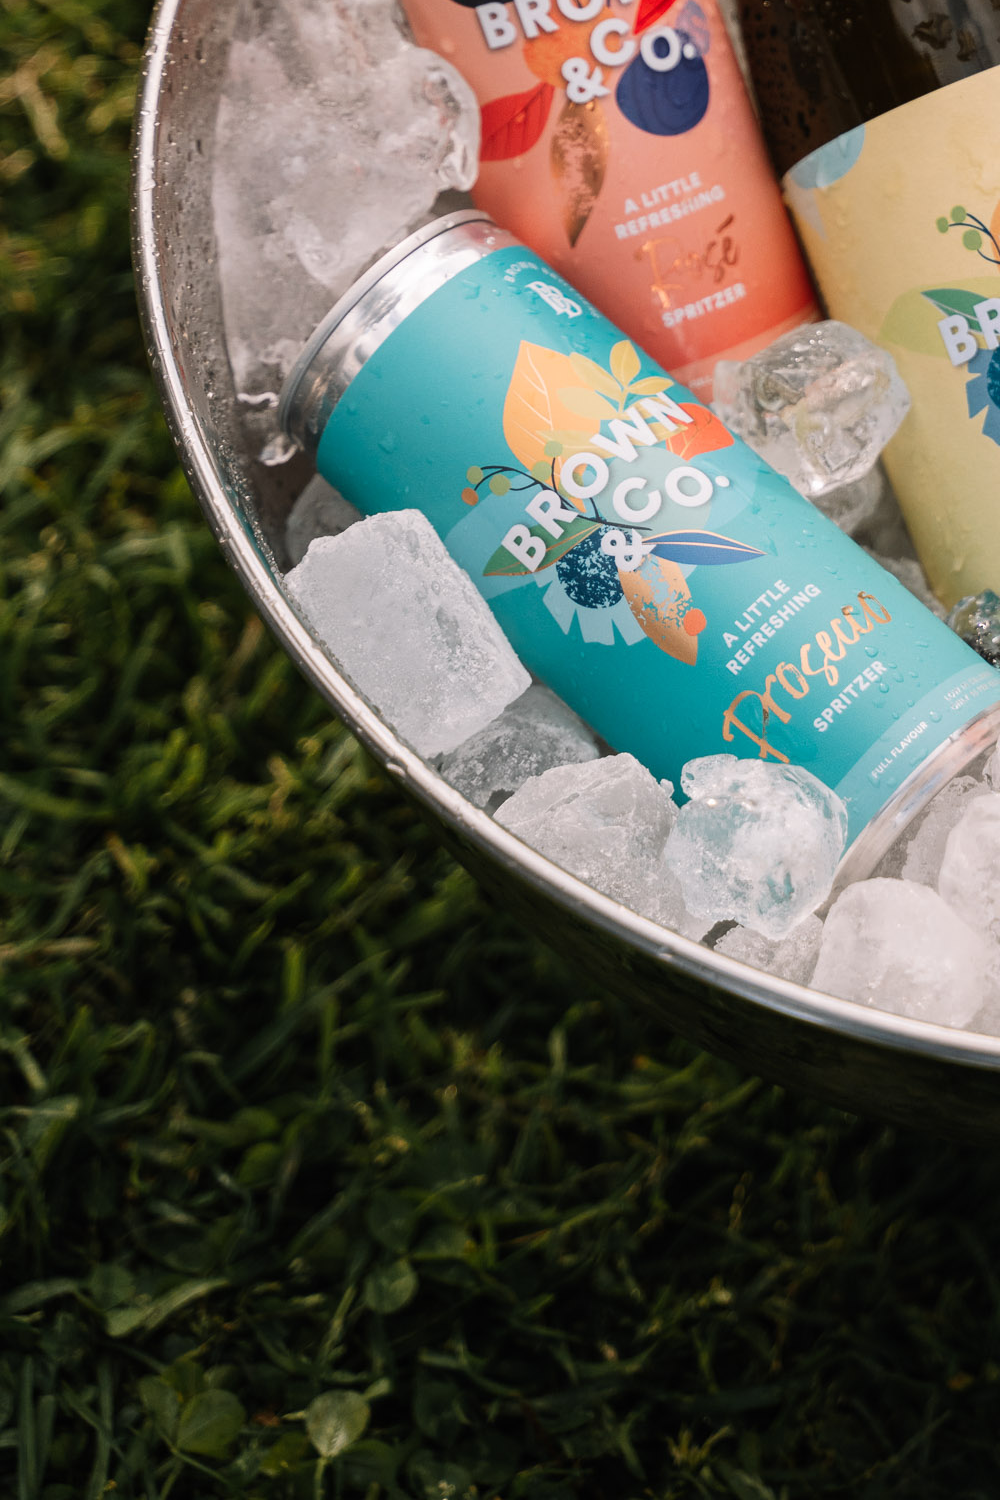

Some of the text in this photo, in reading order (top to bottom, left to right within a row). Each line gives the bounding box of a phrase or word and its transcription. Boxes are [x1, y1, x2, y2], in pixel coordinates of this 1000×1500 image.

[561, 18, 697, 103] & CO.
[614, 184, 726, 240] REFRESHING
[624, 171, 702, 215] A LITTLE
[662, 282, 747, 328] SPRITZER
[501, 391, 694, 573] BROWN
[601, 466, 730, 572] & CO.
[722, 579, 791, 648] A LITTLE
[725, 583, 822, 676] REFRESHING
[722, 591, 892, 764] Prosecco
[813, 660, 887, 732] SPRITZER
[871, 721, 929, 779] FULL FLAVOUR
